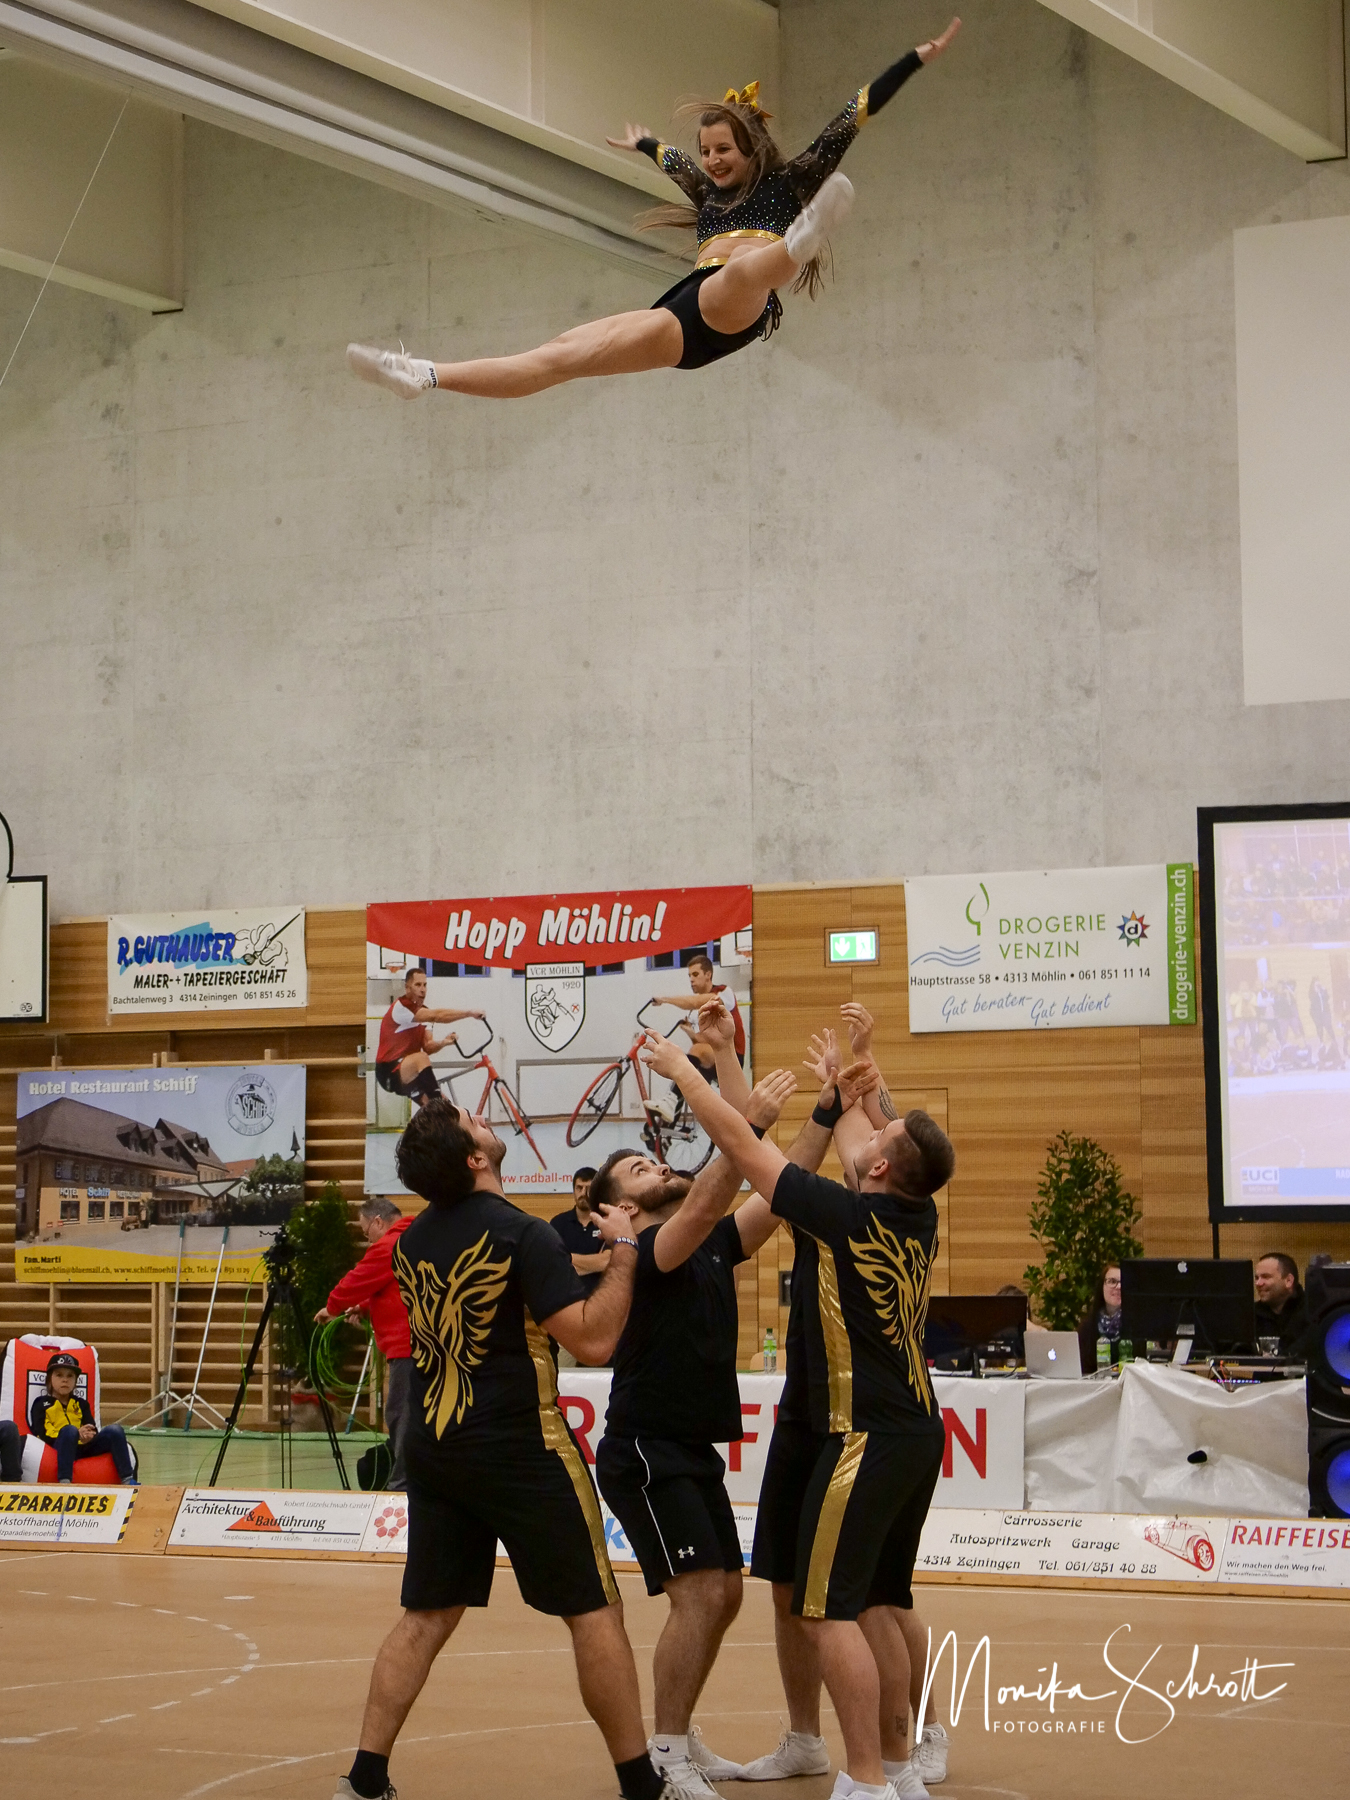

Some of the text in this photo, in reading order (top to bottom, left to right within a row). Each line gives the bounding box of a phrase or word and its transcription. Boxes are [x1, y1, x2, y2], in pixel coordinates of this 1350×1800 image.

[444, 900, 667, 959] Hopp Möhlin!
[999, 914, 1106, 935] DROGERIE
[999, 940, 1080, 960] VENZIN
[1170, 868, 1192, 1019] drogerie-venzin.ch
[133, 973, 174, 989] MALER-
[183, 966, 287, 988] TAPEZIERGESCHÄFT
[530, 965, 581, 976] VCR MÖHLIN
[910, 967, 1151, 988] Hauptstrasse 58 4313 Möhlin 061 851 11 14
[562, 981, 581, 990] 1920
[113, 990, 296, 1005] Bachtalenweg 3 4314 Zeiningen 061 851 45 26
[941, 995, 967, 1023] Gut
[1030, 1002, 1055, 1026] Gut
[1061, 992, 1112, 1016] bedient
[29, 1075, 198, 1095] Hotel Restaurant Schiff
[33, 1374, 47, 1382] VC
[65, 1519, 99, 1528] Möhlin
[182, 1503, 327, 1531] Architektur & Bauführung
[1004, 1514, 1083, 1527] Carrosserie
[950, 1533, 1120, 1552] Autospritzwerk Garage
[1038, 1559, 1059, 1570] Tel.
[1065, 1560, 1114, 1573] 061/851
[1120, 1563, 1136, 1573] 40
[1140, 1564, 1157, 1574] 88
[1242, 1561, 1272, 1570] machen
[1274, 1562, 1289, 1570] den
[1291, 1564, 1309, 1572] Weg
[1311, 1564, 1327, 1572] frei.
